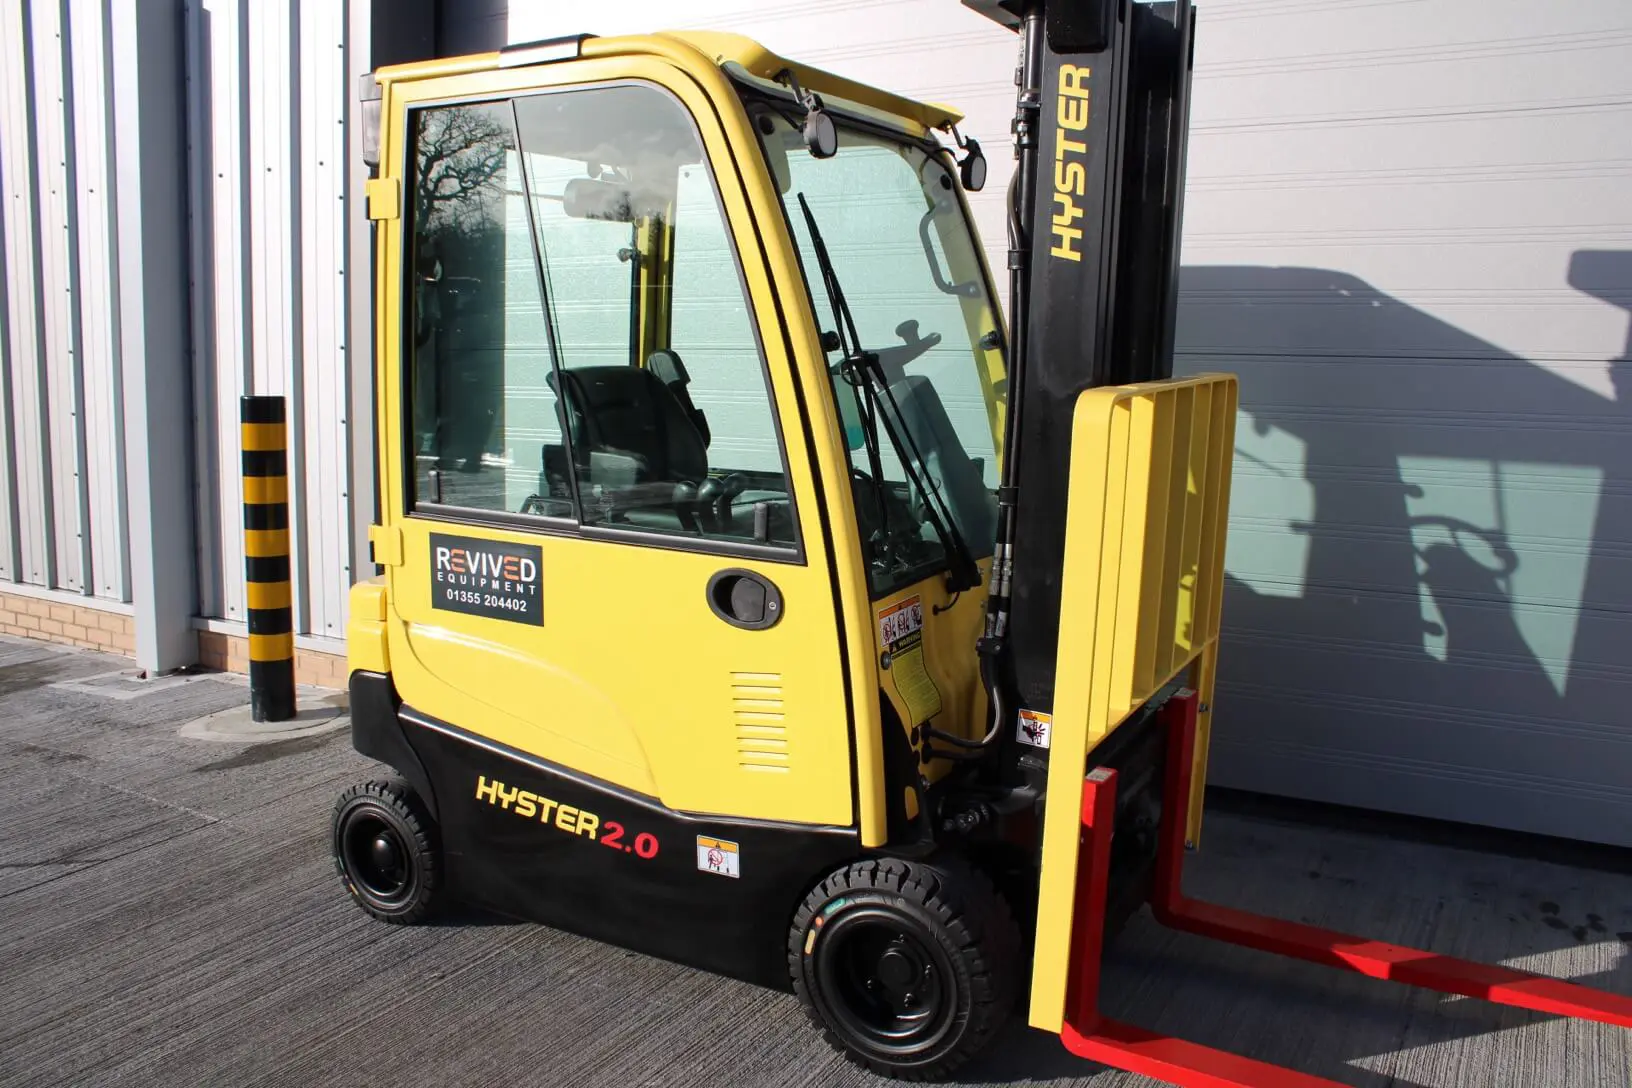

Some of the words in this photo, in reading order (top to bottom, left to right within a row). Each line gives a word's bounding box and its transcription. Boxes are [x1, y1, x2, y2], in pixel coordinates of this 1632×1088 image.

[1051, 64, 1090, 262] HYSTER
[436, 547, 536, 582] REVIVED
[437, 572, 536, 595] EQUIPMENT
[446, 589, 481, 604] 01355
[484, 595, 527, 612] 204402
[475, 775, 599, 840] HYSTER
[601, 822, 659, 859] 2.0
